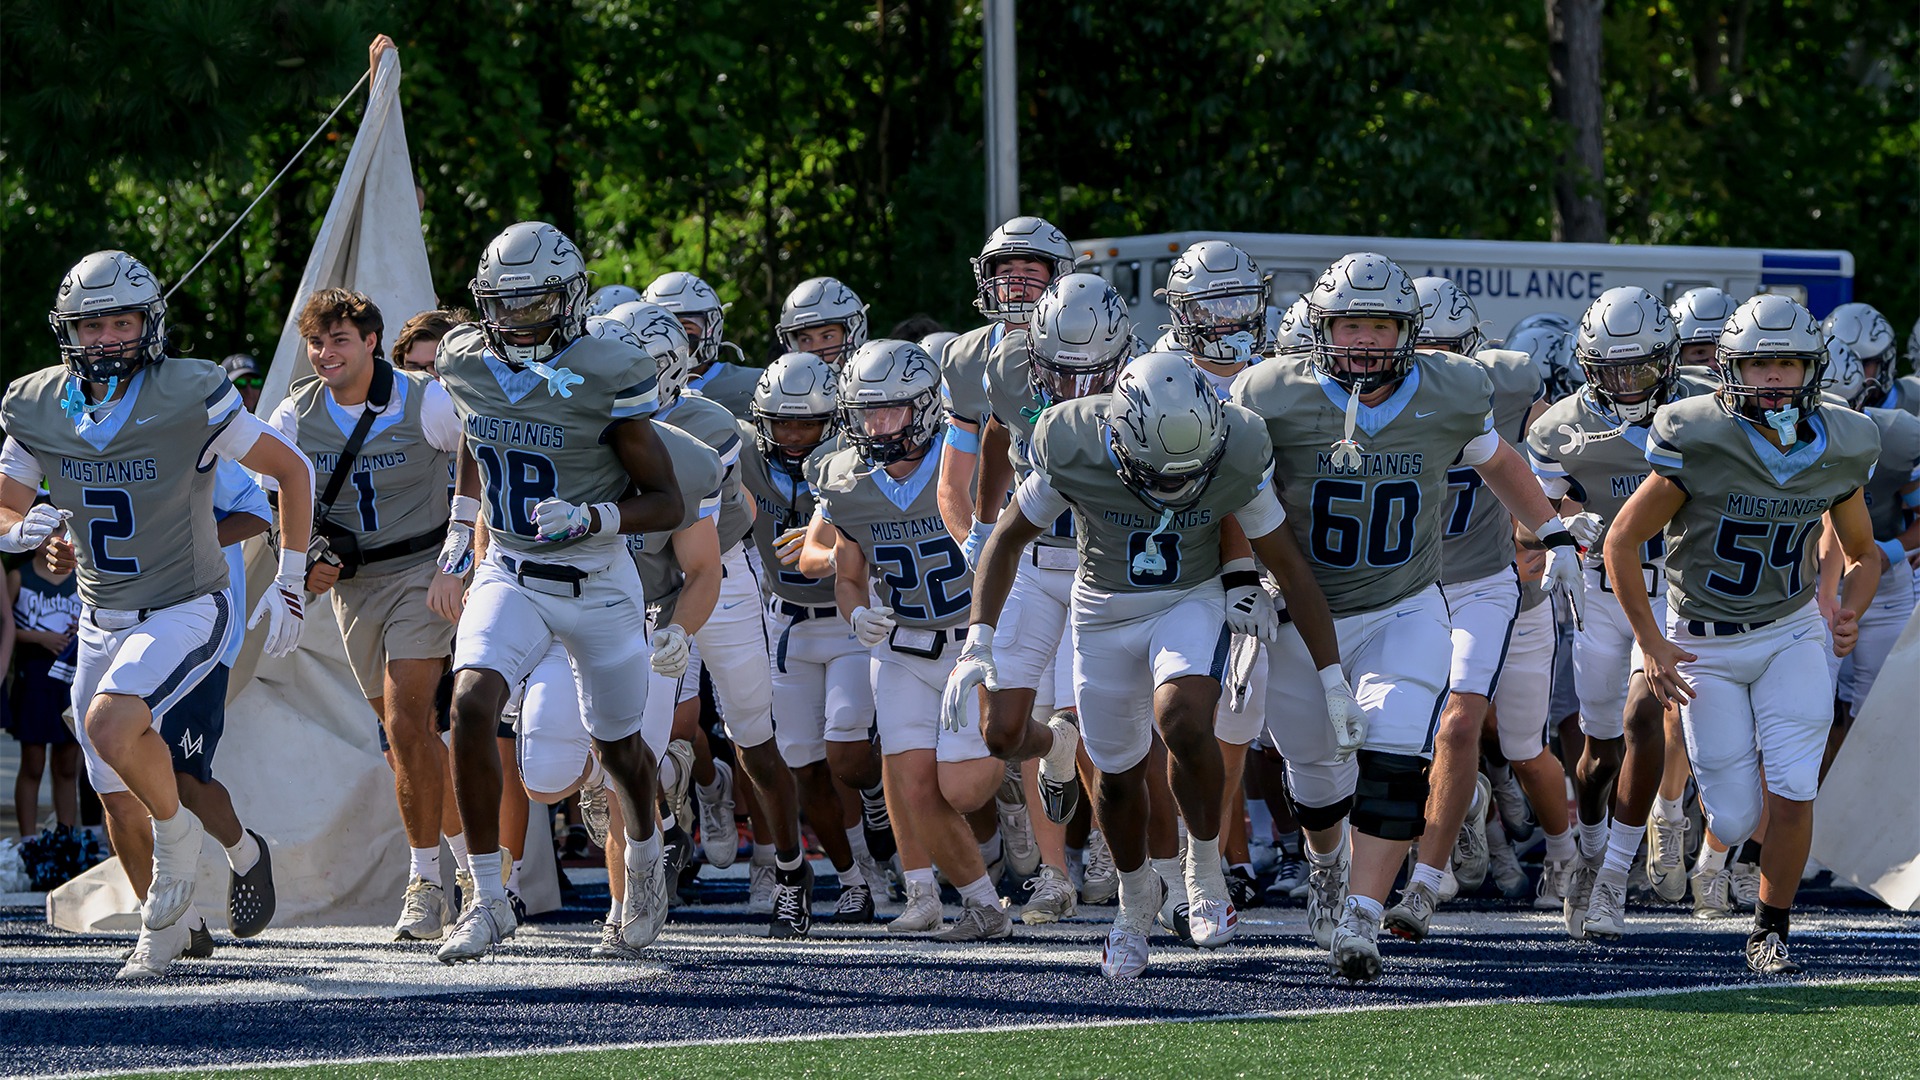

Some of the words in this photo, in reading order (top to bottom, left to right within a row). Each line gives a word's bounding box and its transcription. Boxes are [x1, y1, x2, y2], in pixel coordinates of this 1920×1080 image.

[1211, 280, 1240, 288] MUSTANGS
[84, 297, 114, 306] MUSTANGS
[466, 412, 565, 450] MUSTANGS
[1602, 429, 1621, 439] BALL
[60, 457, 158, 483] MUSTANGS
[315, 451, 408, 473] MUTANGS
[350, 471, 380, 532] 1
[475, 443, 559, 538] 18
[1725, 493, 1828, 519] MUSTANGS
[82, 486, 140, 575] 2
[869, 515, 946, 542] MUSTANG
[1310, 478, 1422, 570] 60
[1705, 515, 1823, 599] 54
[873, 534, 973, 620] 22
